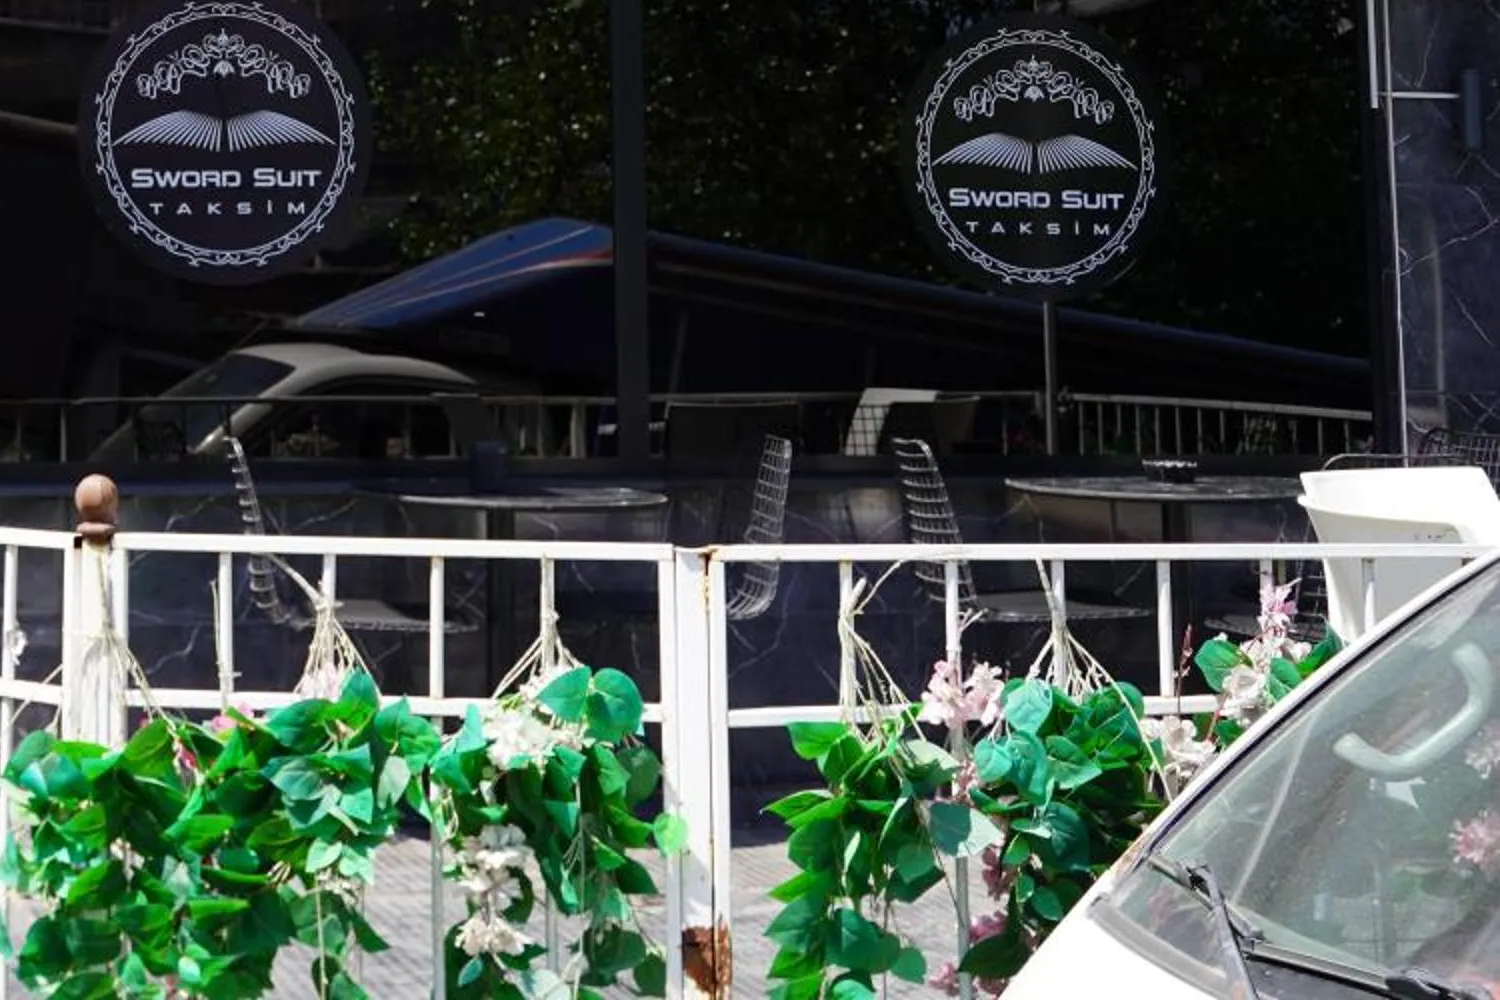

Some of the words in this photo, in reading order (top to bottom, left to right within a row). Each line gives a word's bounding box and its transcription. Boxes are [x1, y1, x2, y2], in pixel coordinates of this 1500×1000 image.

[131, 168, 242, 189] SWORD
[253, 167, 322, 188] SUIT
[949, 188, 1051, 209] SWORD
[1062, 190, 1124, 210] SUIT
